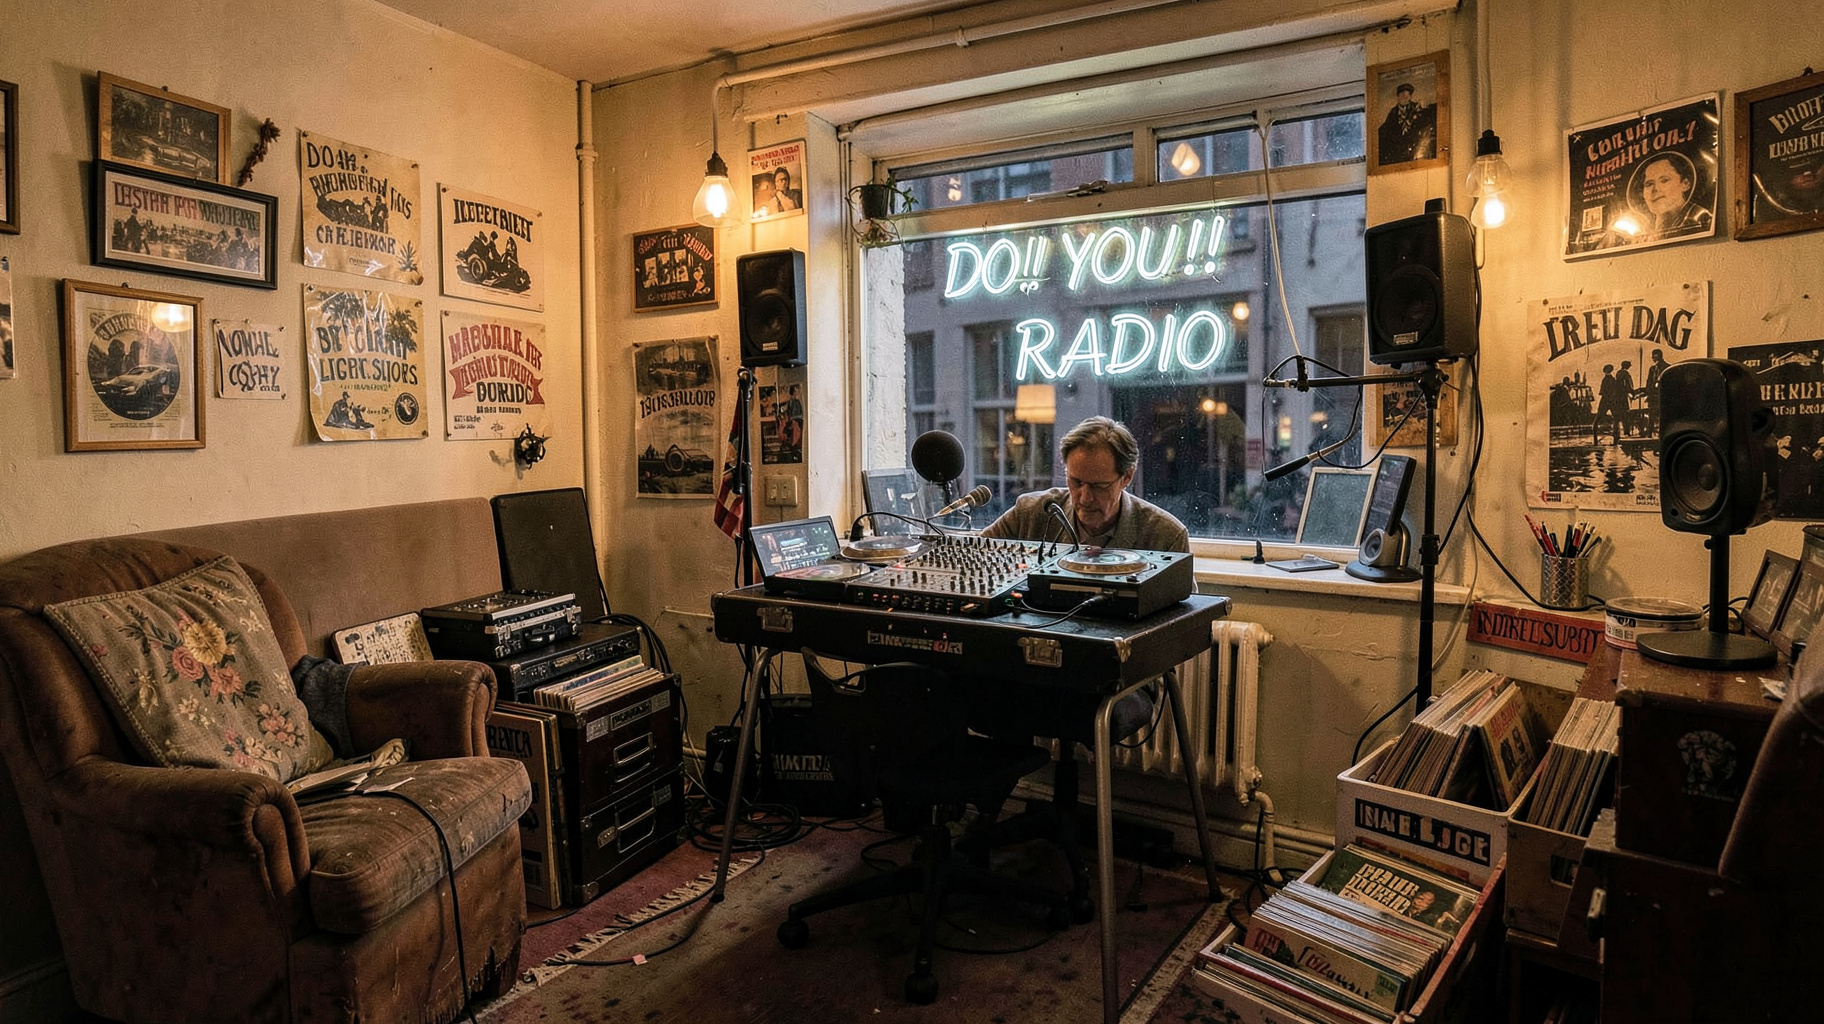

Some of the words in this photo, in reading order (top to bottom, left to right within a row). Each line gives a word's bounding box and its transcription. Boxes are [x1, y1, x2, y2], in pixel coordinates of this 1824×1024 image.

[944, 235, 1047, 298] DO!!
[1062, 215, 1225, 291] YOU!!
[1015, 310, 1225, 381] RADIO
[1629, 306, 1697, 350] DAG
